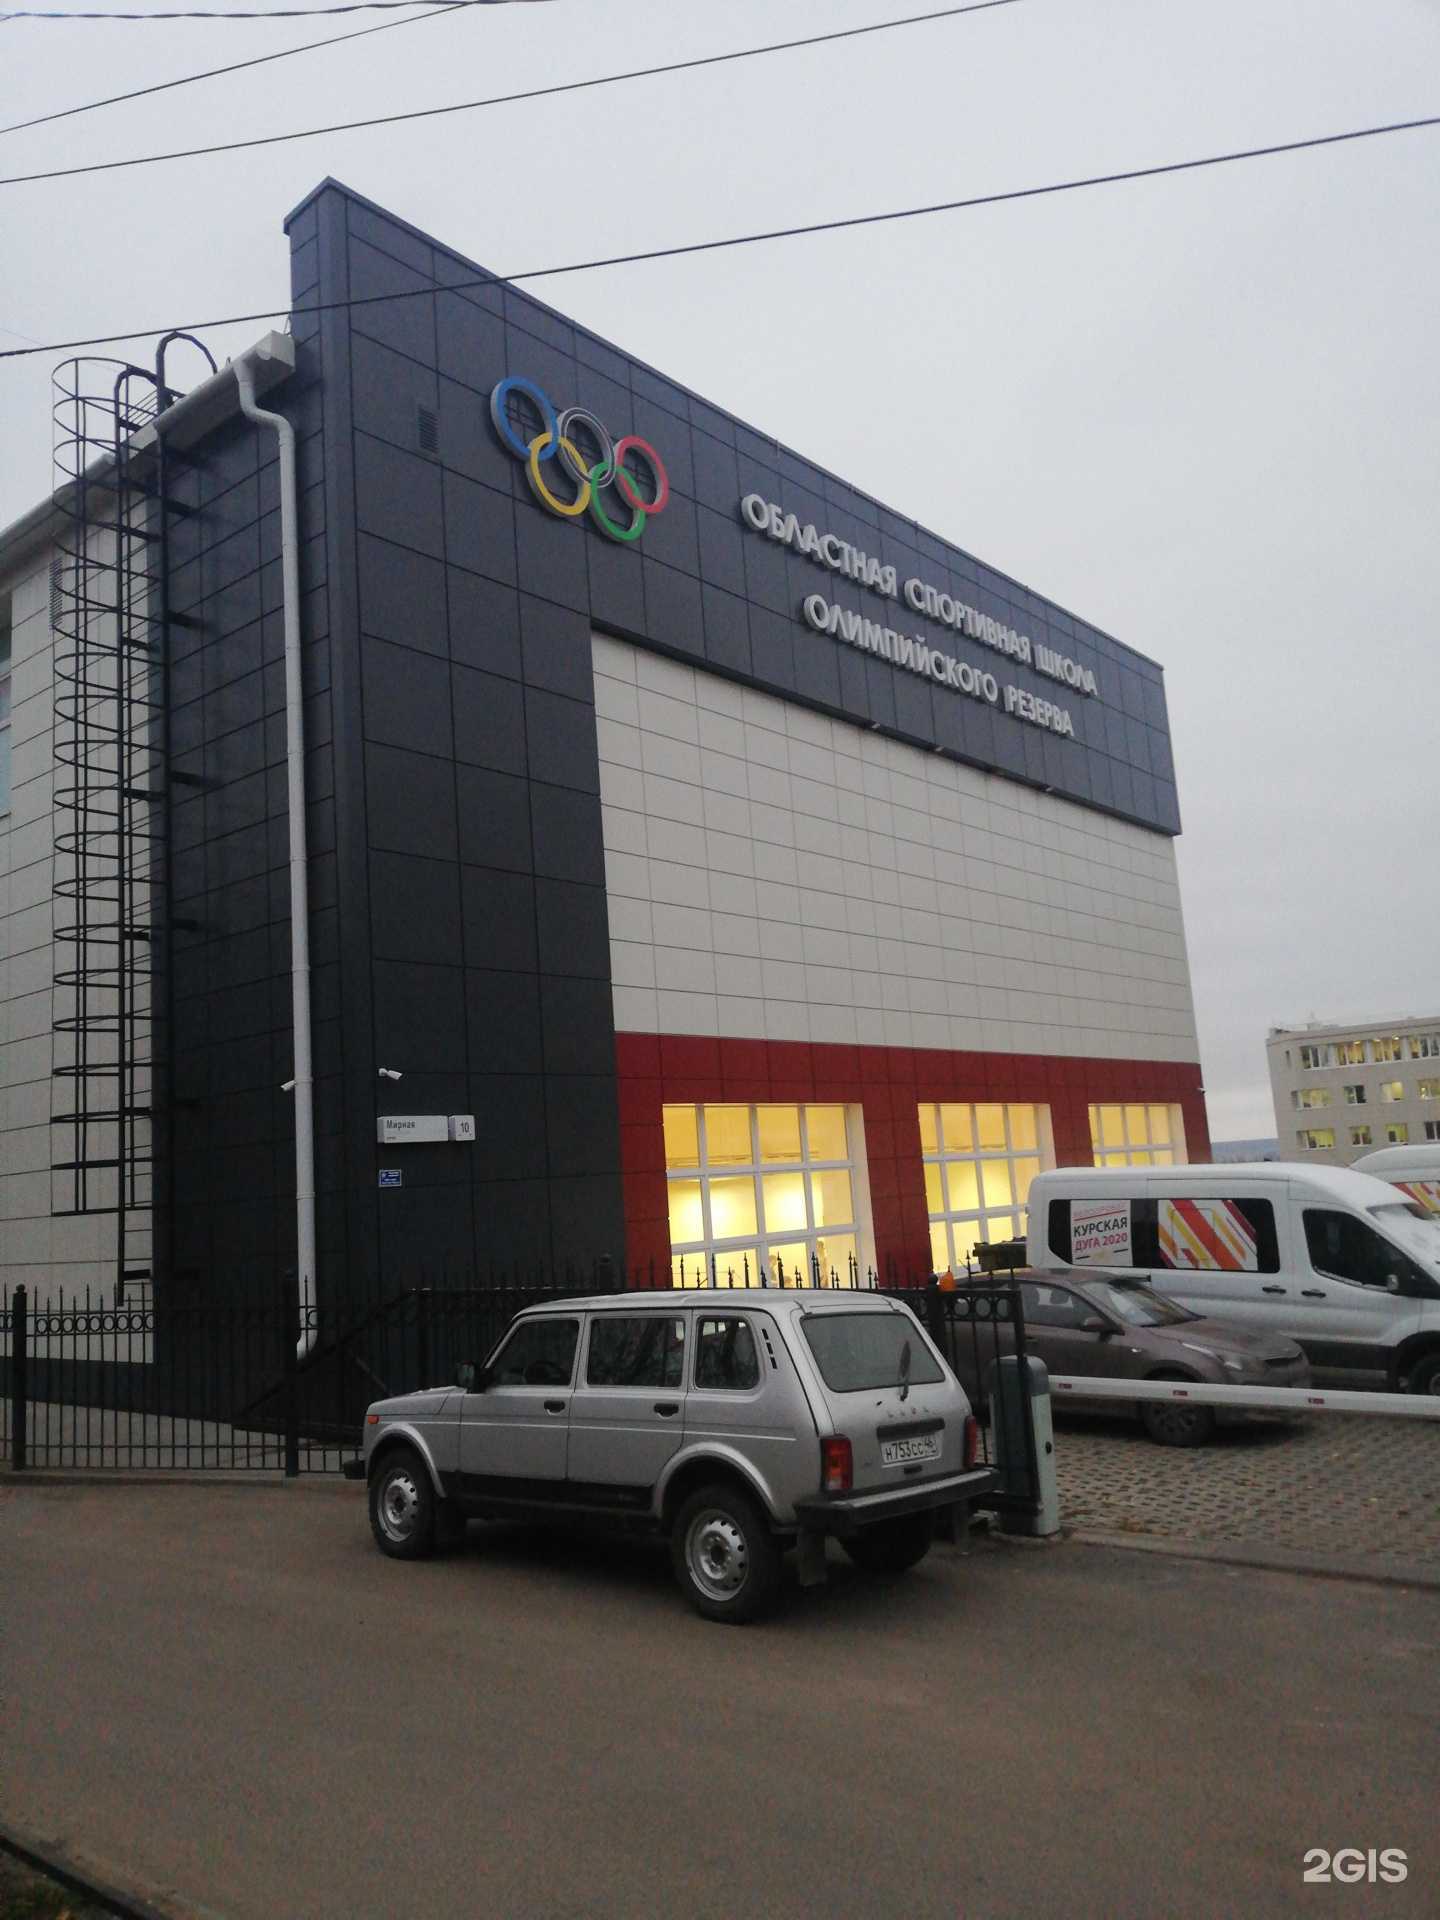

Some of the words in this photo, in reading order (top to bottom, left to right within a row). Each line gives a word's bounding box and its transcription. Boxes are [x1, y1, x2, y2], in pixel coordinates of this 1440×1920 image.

[741, 493, 898, 597] ОБЛАСТНАЯ
[903, 577, 1032, 663] СПОРТИВНАЯ
[1033, 644, 1098, 696] ШКОЛА
[802, 593, 998, 702] ОЛИМПИЙСКОГО
[1003, 684, 1075, 737] РЕЗЕРВА
[386, 1119, 416, 1131] Мирная
[460, 1121, 470, 1133] 10
[1073, 1216, 1128, 1238] КУРСКАЯ
[1075, 1237, 1100, 1251] ДУГА
[1102, 1232, 1128, 1246] 2020
